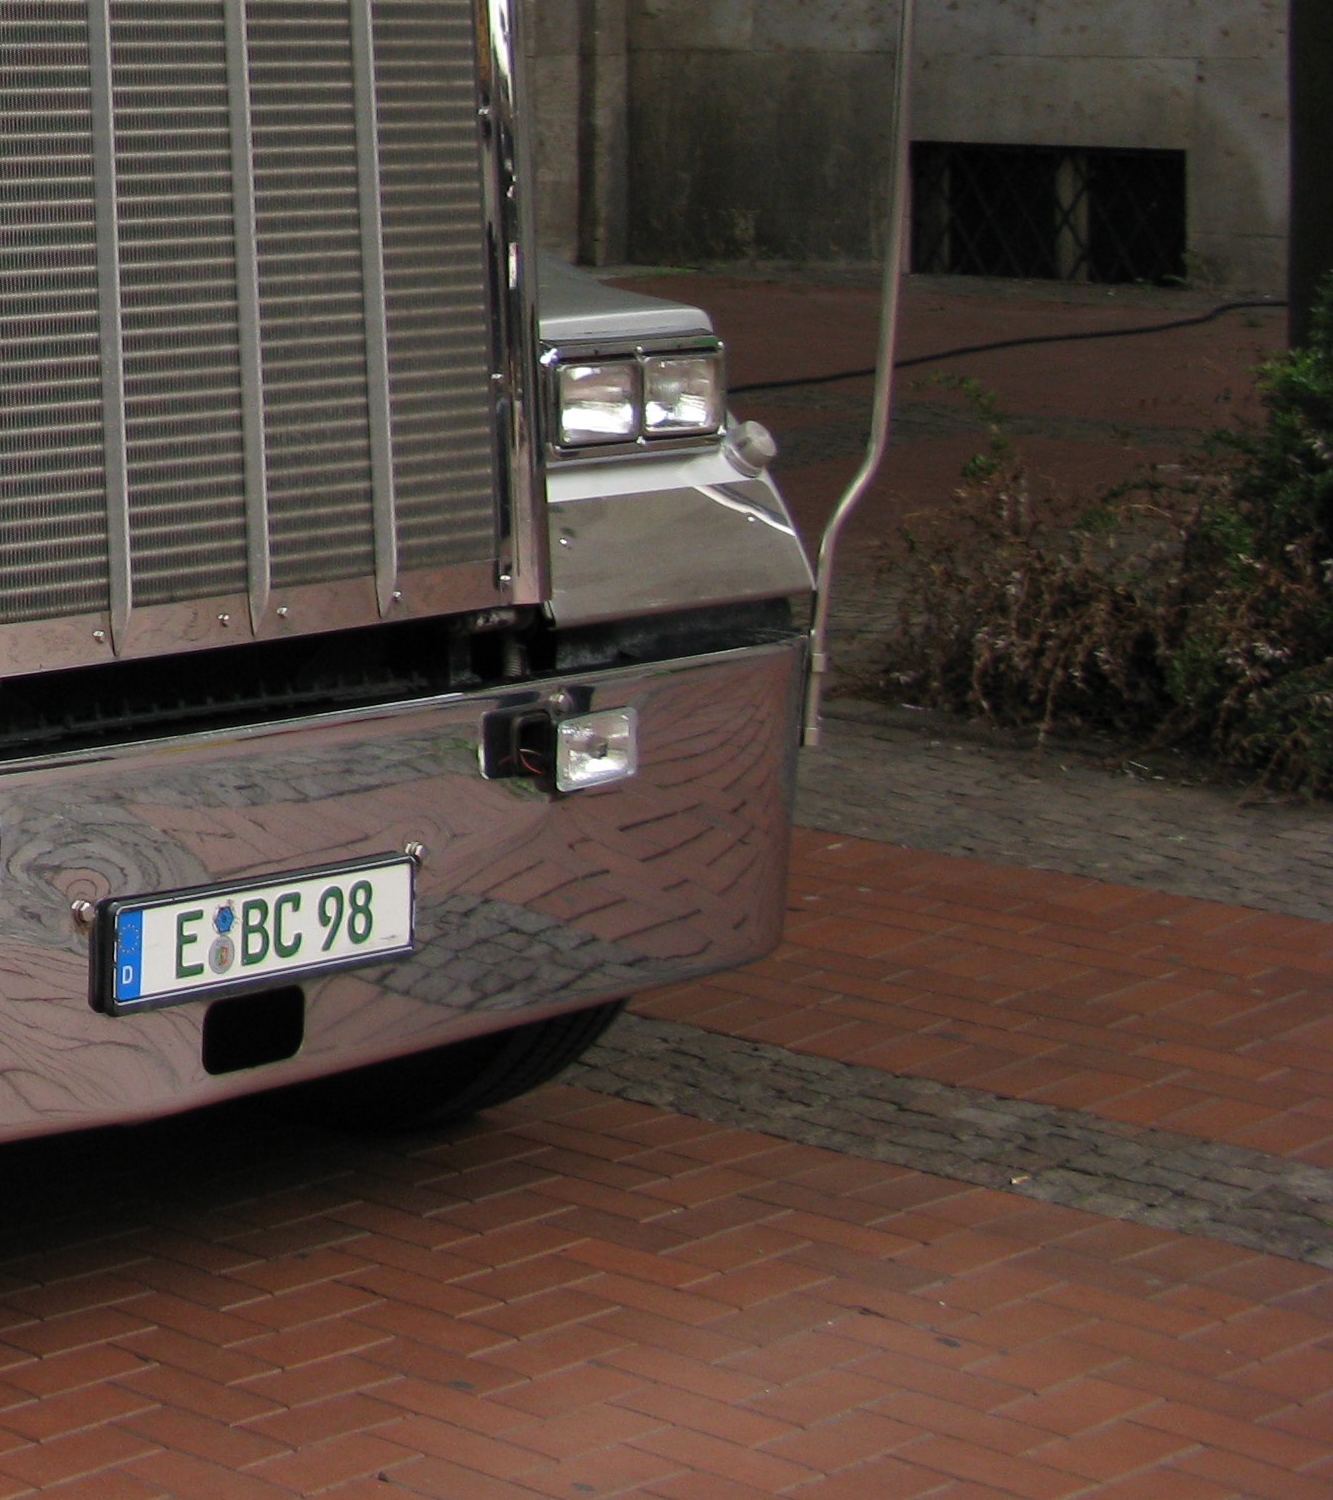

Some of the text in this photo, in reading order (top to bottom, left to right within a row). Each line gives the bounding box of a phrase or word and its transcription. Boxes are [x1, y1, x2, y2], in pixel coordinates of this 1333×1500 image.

[176, 879, 374, 979] E BC 98
[121, 965, 133, 985] D
